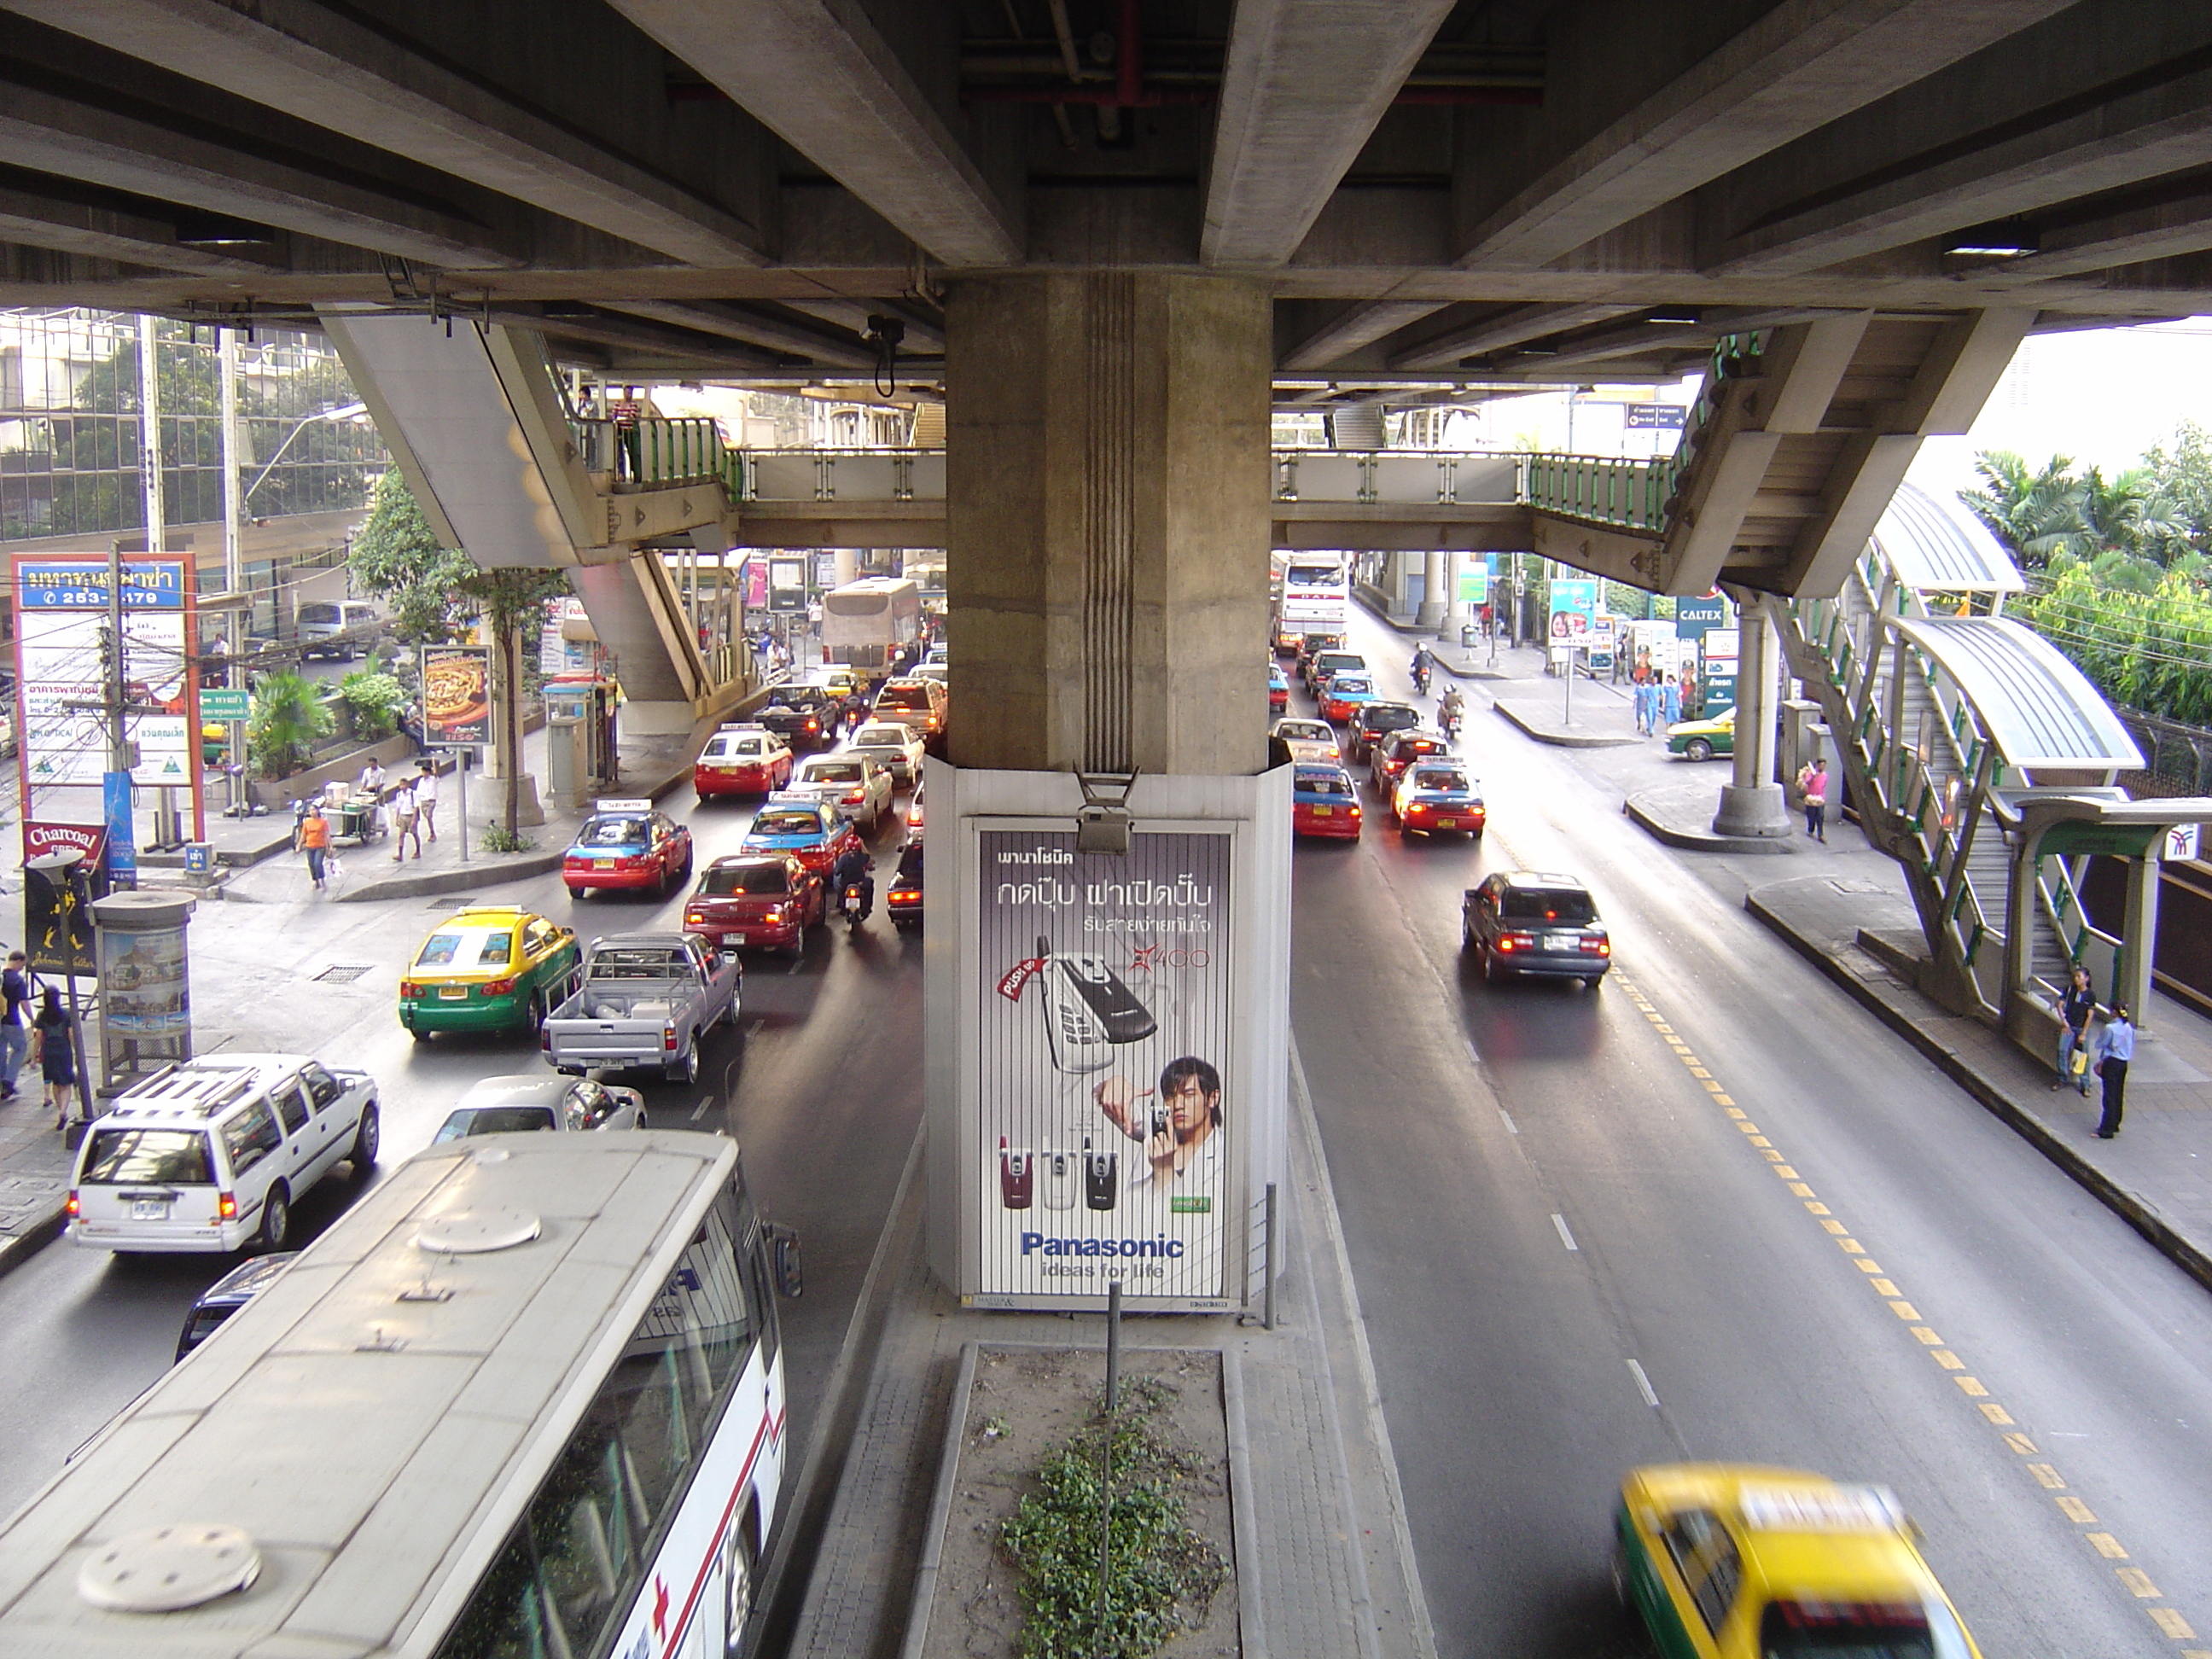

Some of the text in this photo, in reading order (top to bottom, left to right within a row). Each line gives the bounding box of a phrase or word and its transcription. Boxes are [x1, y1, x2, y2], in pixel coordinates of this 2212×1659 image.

[1680, 609, 1722, 620] CALTEX
[30, 827, 97, 850] Charcoal
[1003, 960, 1035, 996] PUSH UP
[1022, 1231, 1185, 1258] Panasonic
[1042, 1261, 1165, 1278] ideas for life
